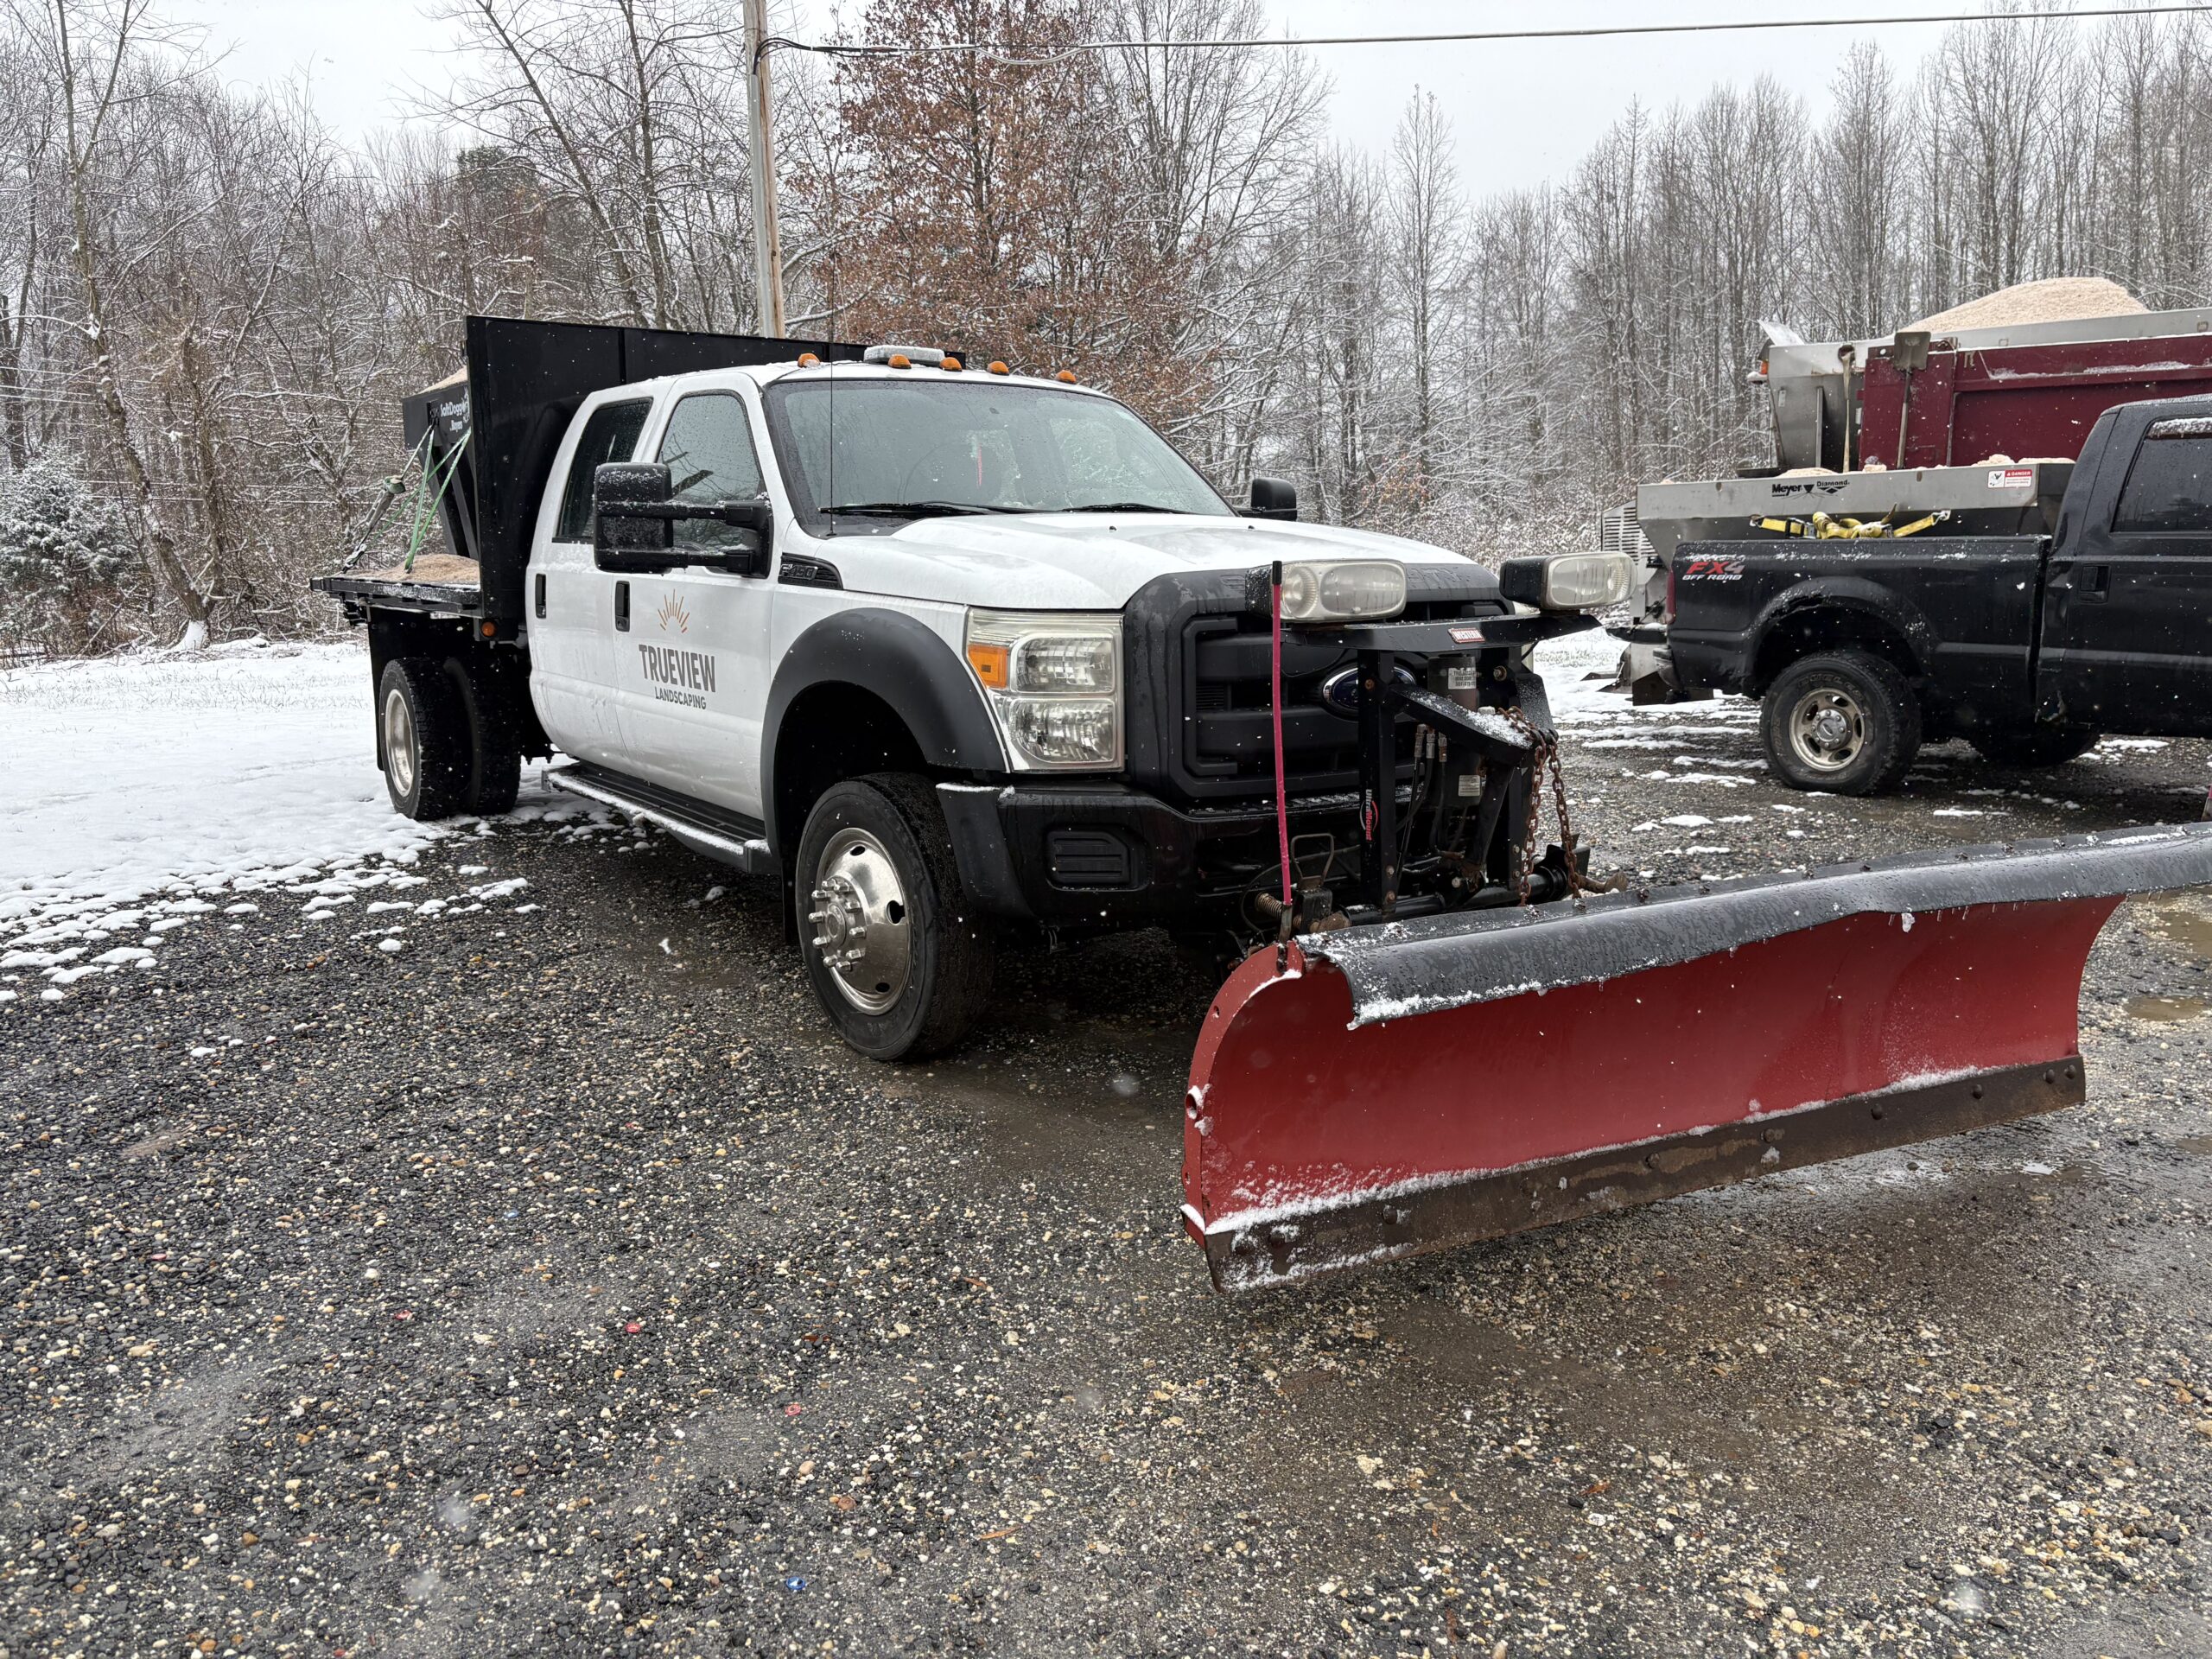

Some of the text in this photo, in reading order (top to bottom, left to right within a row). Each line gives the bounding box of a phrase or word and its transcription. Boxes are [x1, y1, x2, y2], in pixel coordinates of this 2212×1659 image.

[1772, 484, 1802, 496] Meyer
[1686, 561, 1745, 575] FX4
[639, 644, 716, 693] TRUEVIEW
[654, 686, 707, 709] LANDSCAPING
